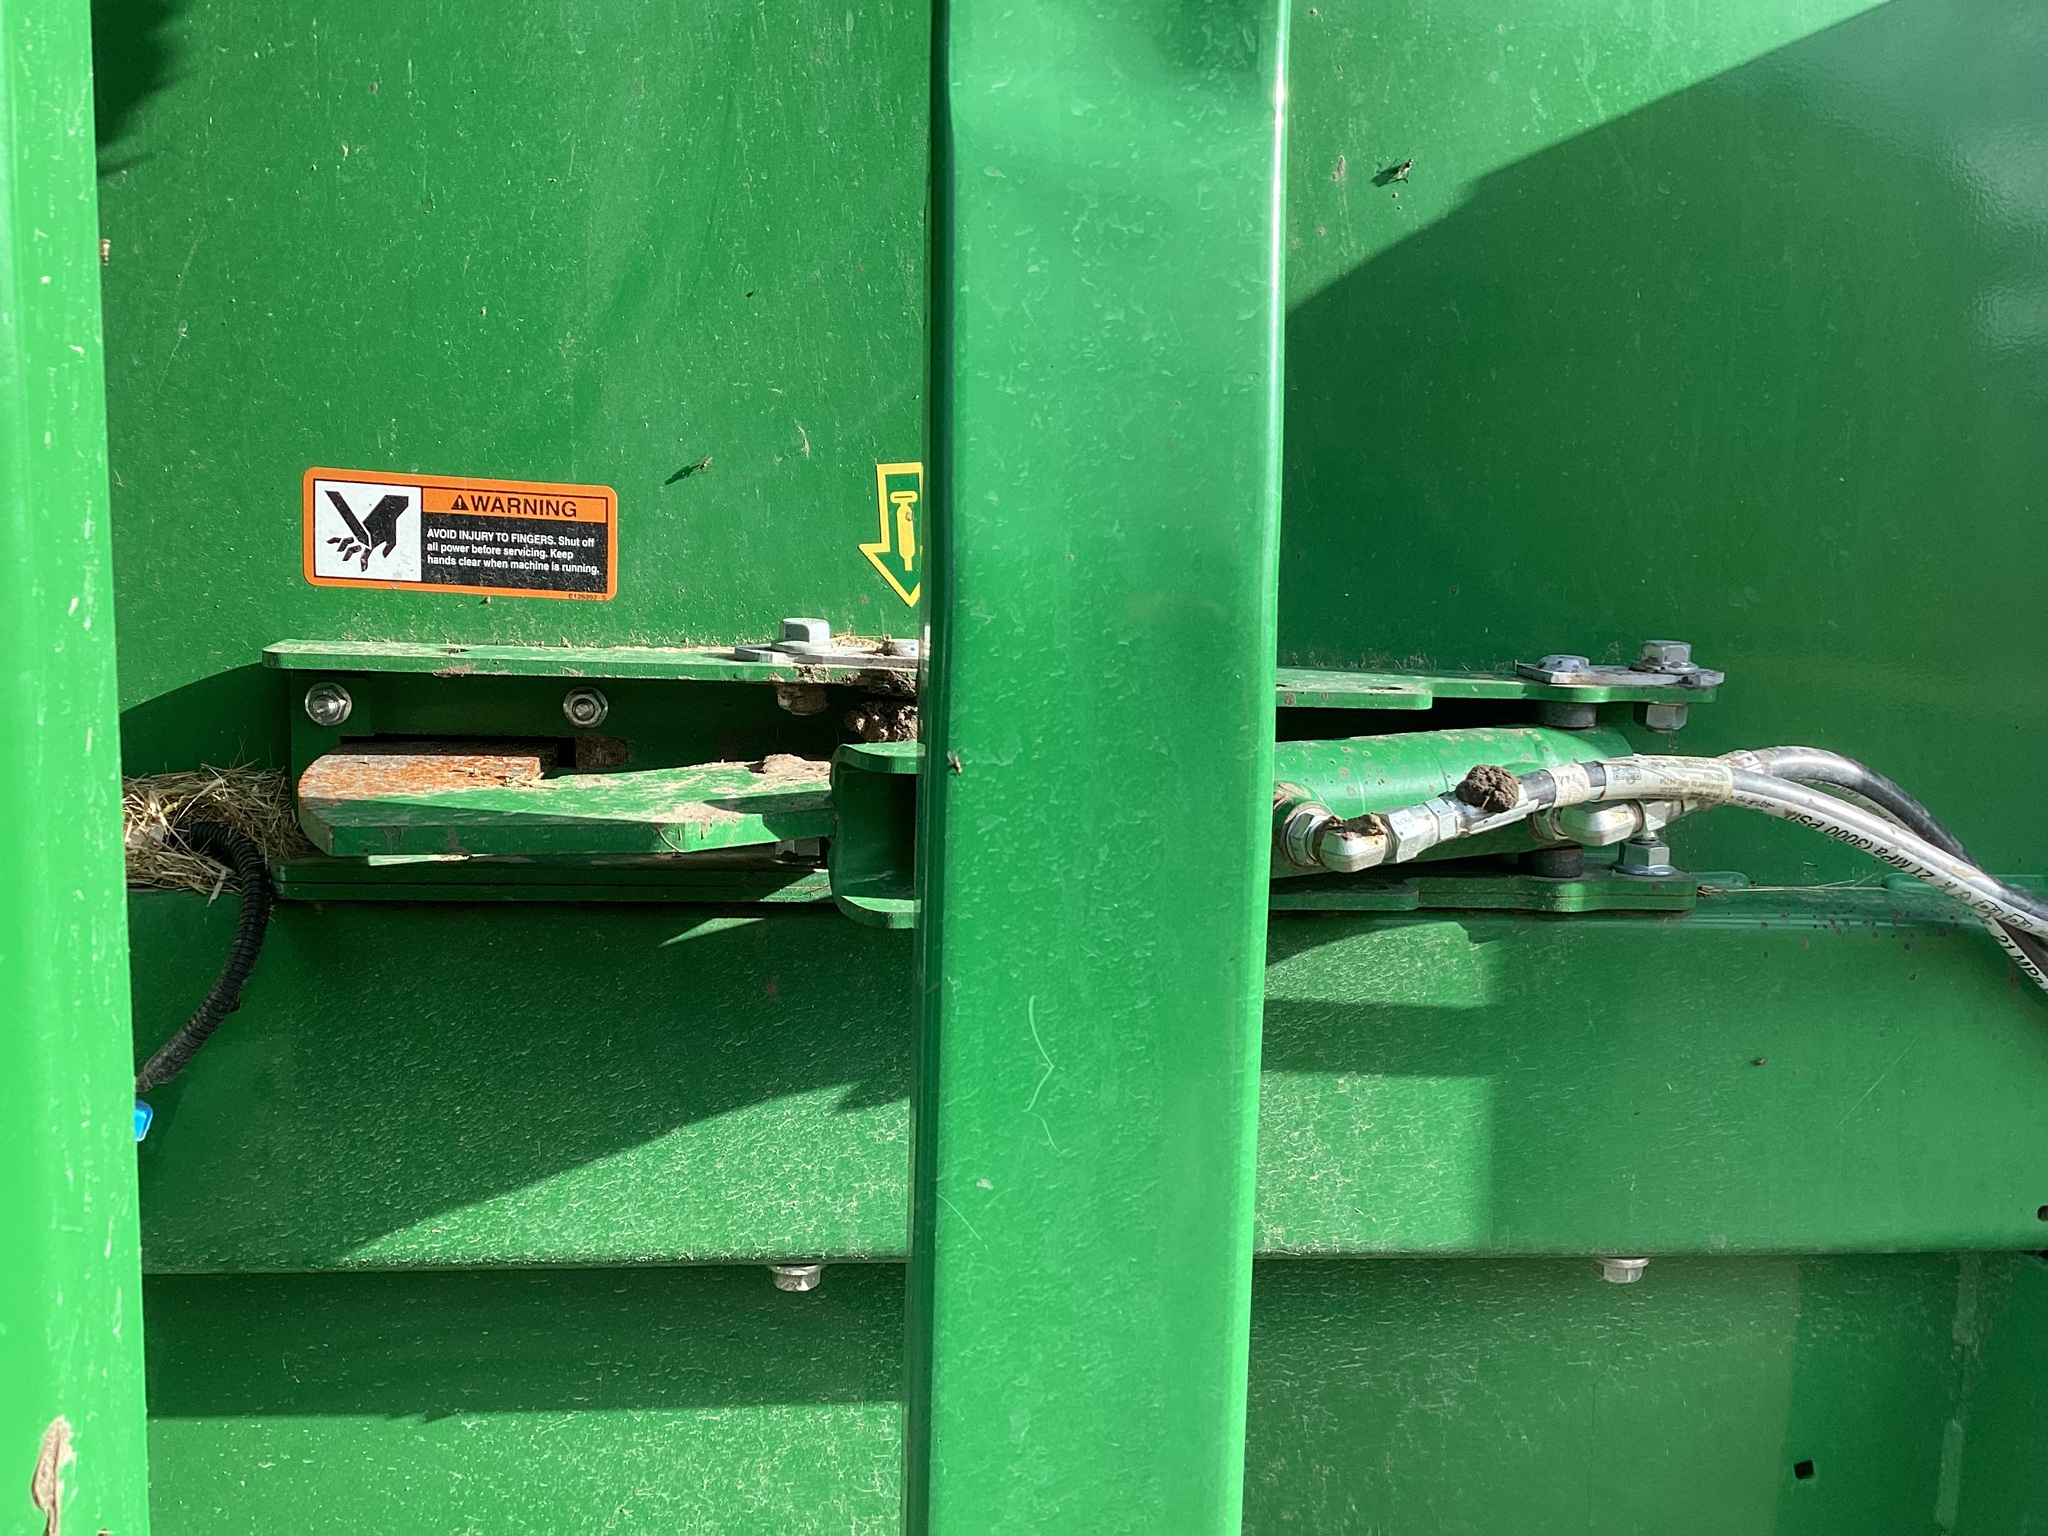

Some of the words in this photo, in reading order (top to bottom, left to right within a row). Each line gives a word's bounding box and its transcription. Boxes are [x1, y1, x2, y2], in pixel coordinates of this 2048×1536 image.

[470, 495, 577, 517] WARNING
[427, 527, 456, 540] AVOID
[458, 529, 493, 542] INJURY
[495, 532, 509, 543] TO
[511, 533, 556, 546] FINGERS.
[558, 535, 581, 547] Shut
[582, 537, 595, 548] off
[427, 541, 439, 552] all
[440, 543, 470, 555] power
[471, 544, 501, 555] before
[503, 546, 548, 560] servicing.
[550, 548, 574, 561] Keep
[427, 554, 456, 566] hands
[458, 556, 481, 567] clear
[483, 557, 508, 569] when
[510, 559, 549, 571] machine
[551, 562, 560, 572] is
[562, 563, 600, 576] running.
[1823, 825, 1874, 850] (3000
[1874, 845, 1913, 870] MPa
[1911, 868, 1936, 882] 21
